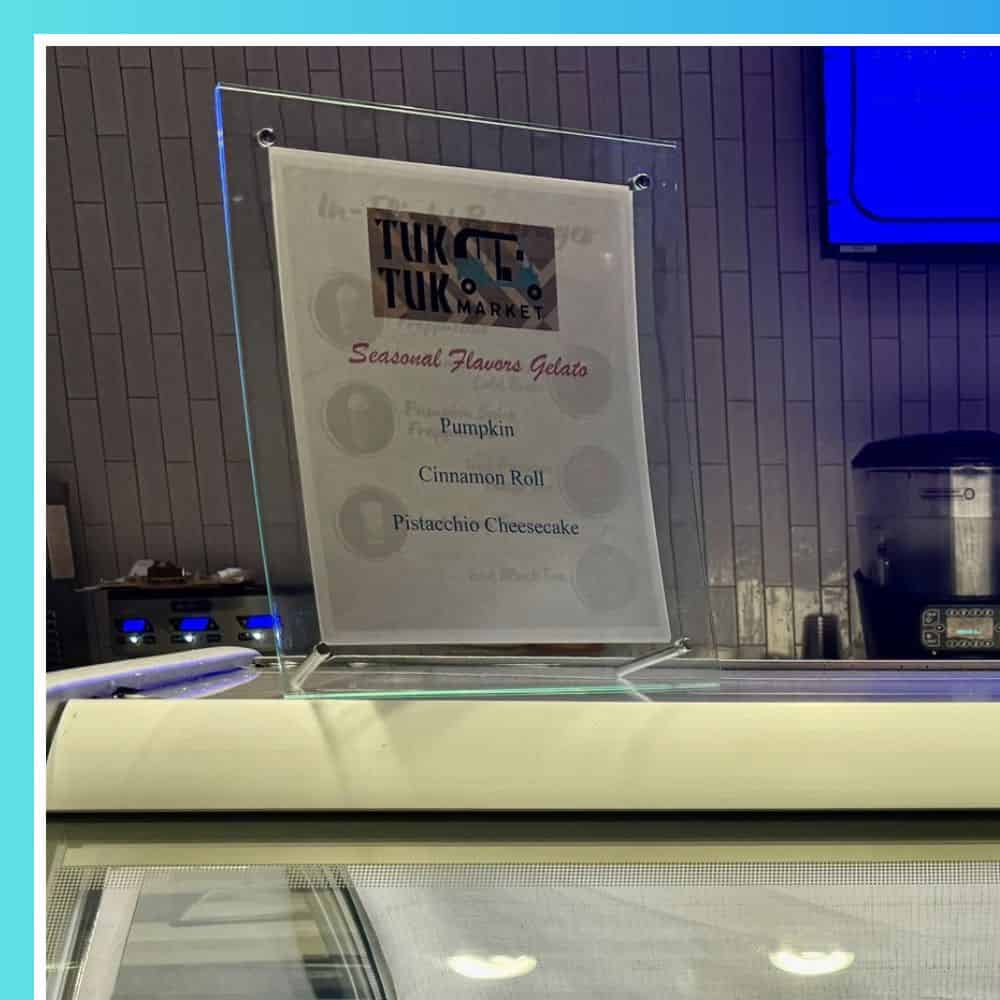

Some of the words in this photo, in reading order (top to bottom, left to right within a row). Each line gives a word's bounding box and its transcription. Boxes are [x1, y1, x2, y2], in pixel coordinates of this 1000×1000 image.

[374, 218, 448, 266] TUK
[377, 267, 454, 315] TUK
[457, 301, 545, 320] MARKET
[347, 342, 442, 369] Seasonal
[448, 349, 522, 374] Flavors
[530, 355, 589, 379] Gelato
[440, 417, 515, 440] Pumpkin
[418, 465, 505, 487] Cinnamon
[511, 468, 545, 488] Roll
[392, 513, 480, 535] Pistacchio
[484, 515, 581, 537] Cheesecake
